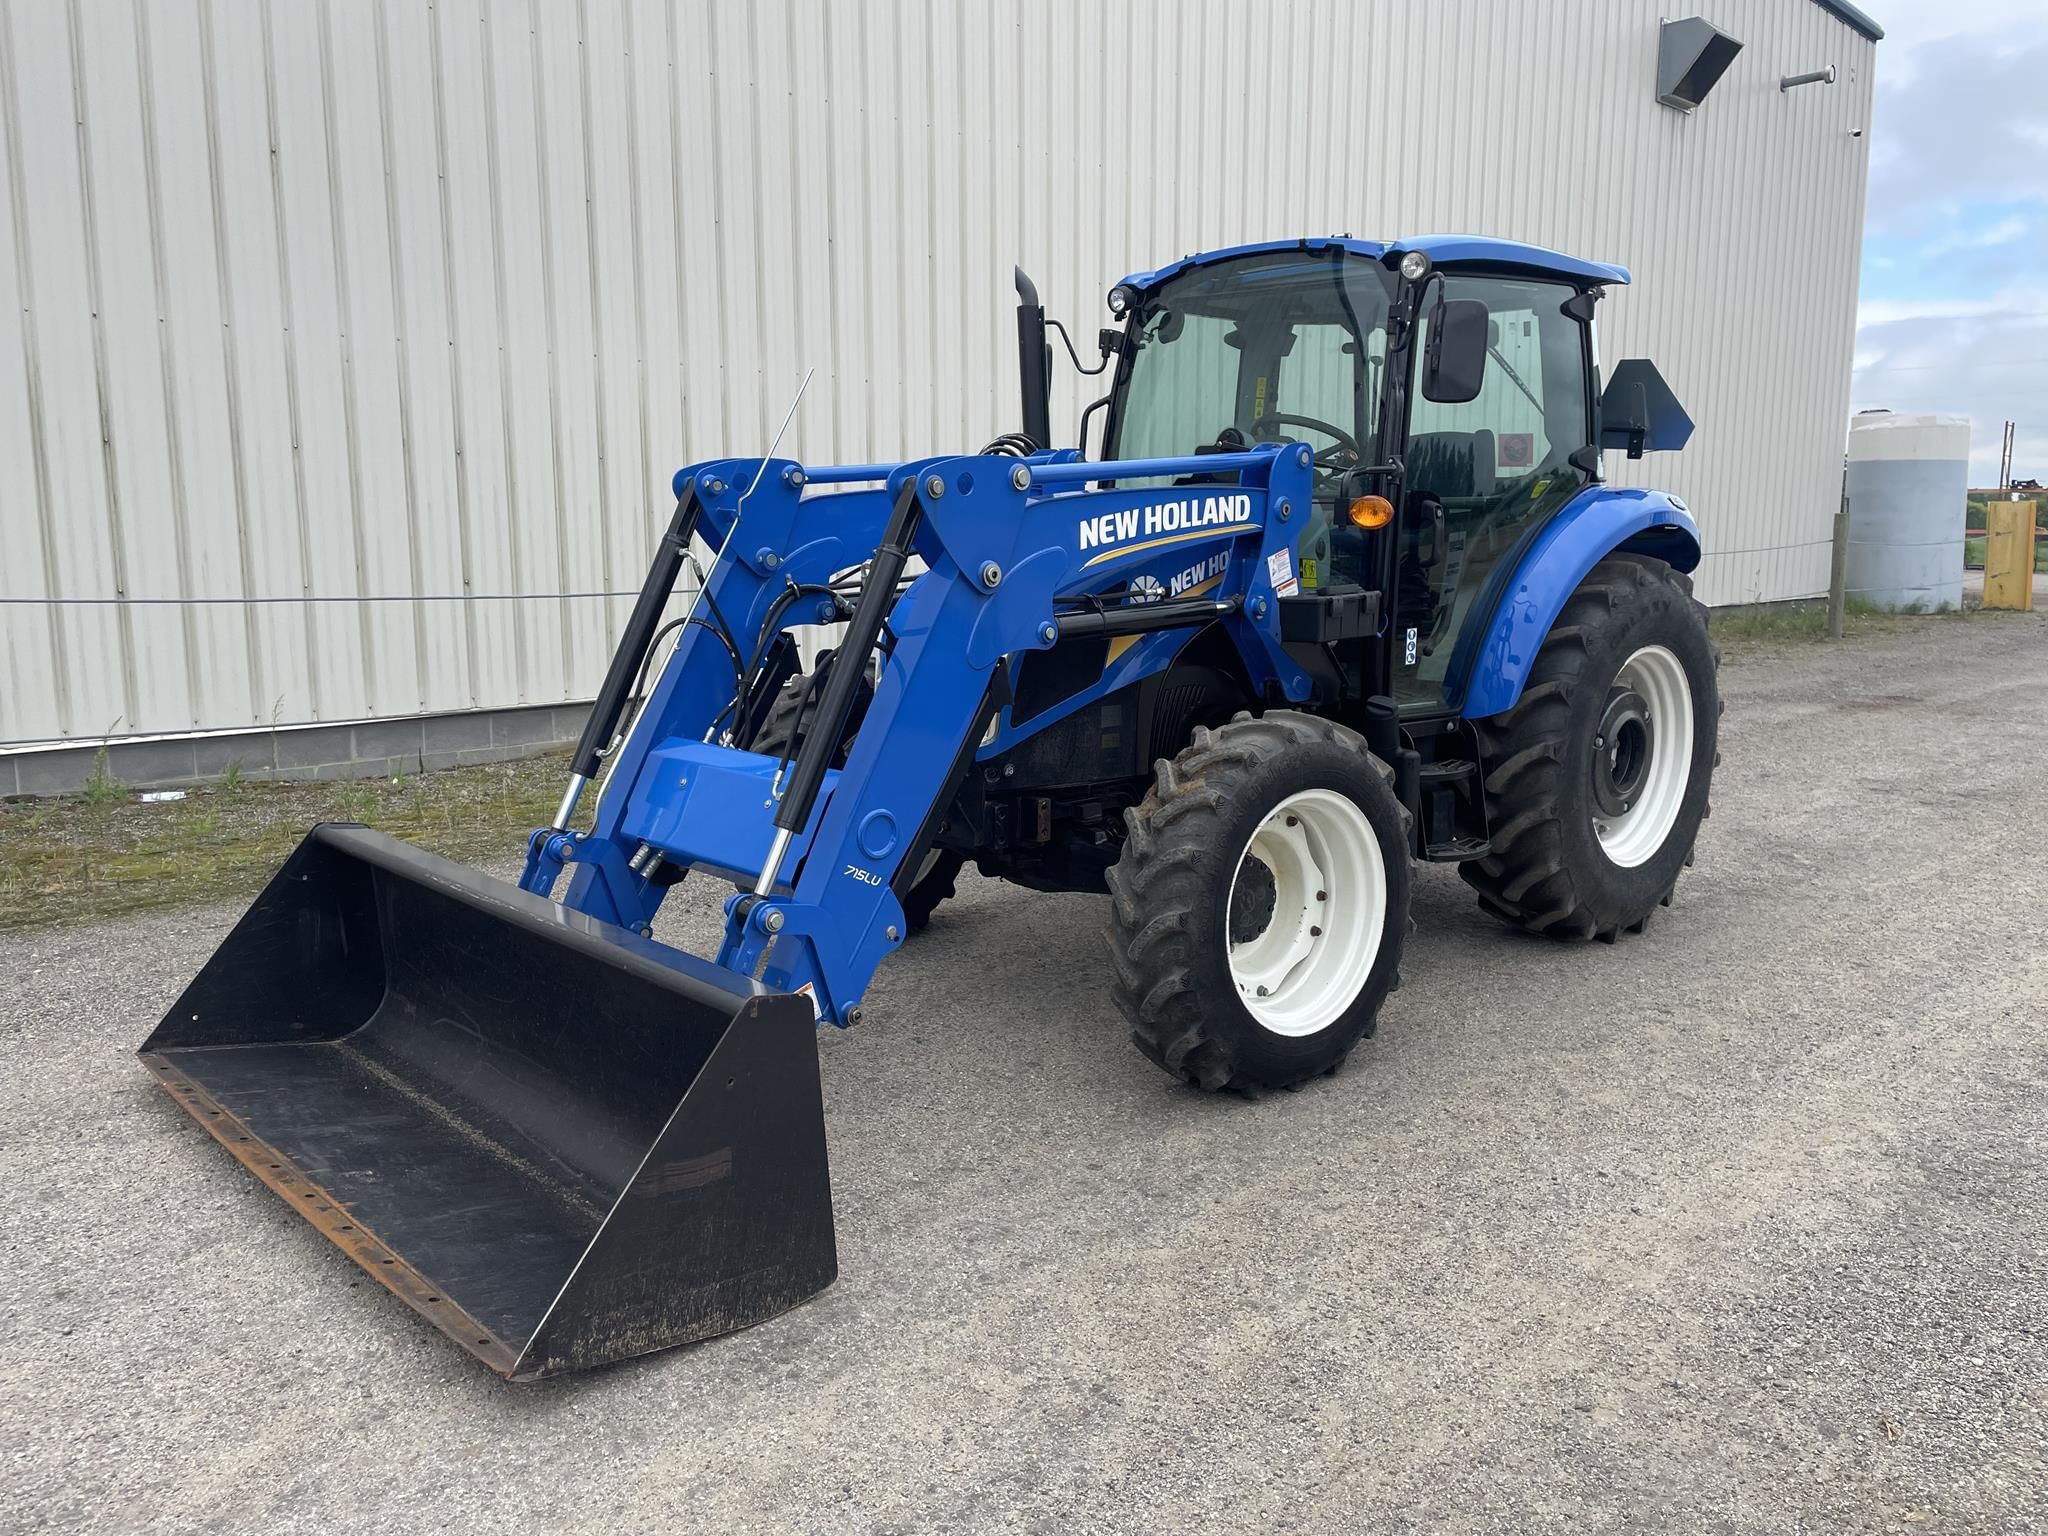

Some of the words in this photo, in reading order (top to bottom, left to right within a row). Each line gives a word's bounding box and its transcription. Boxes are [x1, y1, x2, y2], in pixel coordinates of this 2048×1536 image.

[1079, 508, 1140, 550] NEW
[1144, 494, 1251, 535] HOLLAND
[1170, 561, 1206, 597] NEW
[1208, 549, 1233, 577] HO
[843, 864, 882, 886] 715LU
